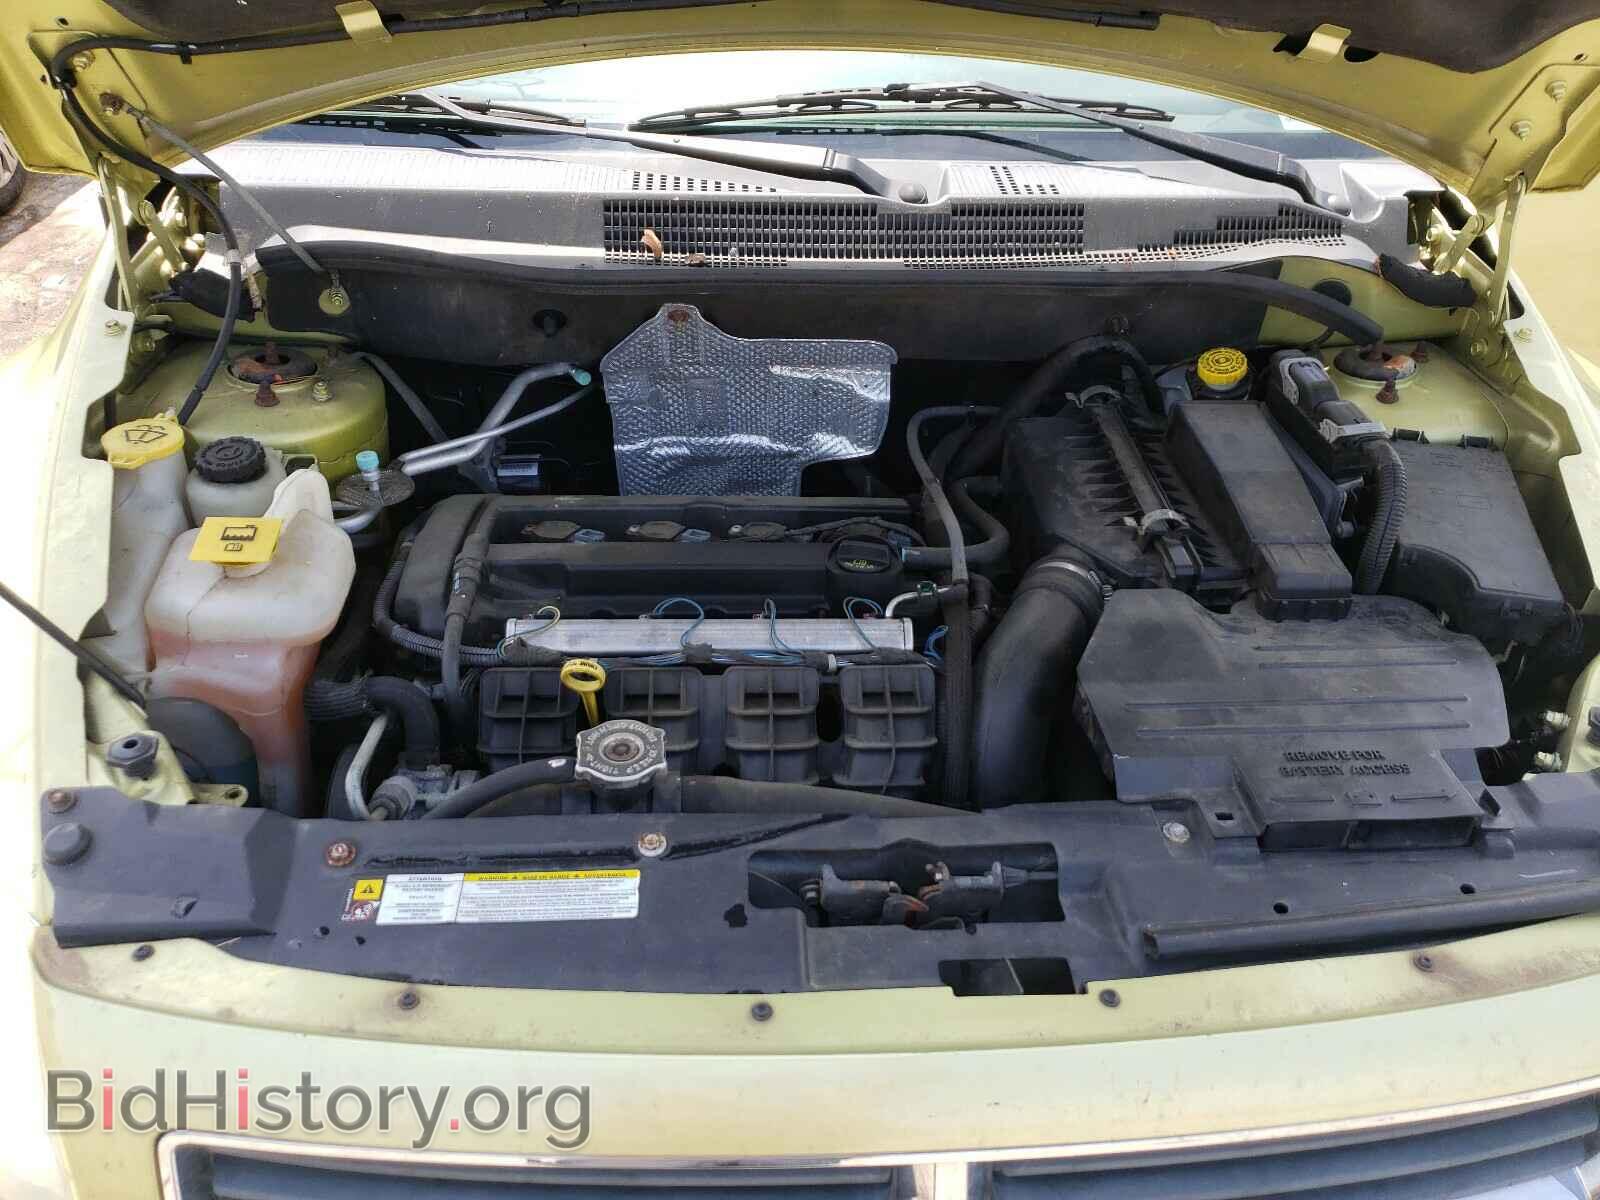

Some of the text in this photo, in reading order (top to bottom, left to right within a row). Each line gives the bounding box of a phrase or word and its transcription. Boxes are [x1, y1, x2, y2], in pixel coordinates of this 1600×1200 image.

[1283, 750, 1386, 762] REMOVE FOR
[1279, 763, 1411, 778] BATTERY ACCESS
